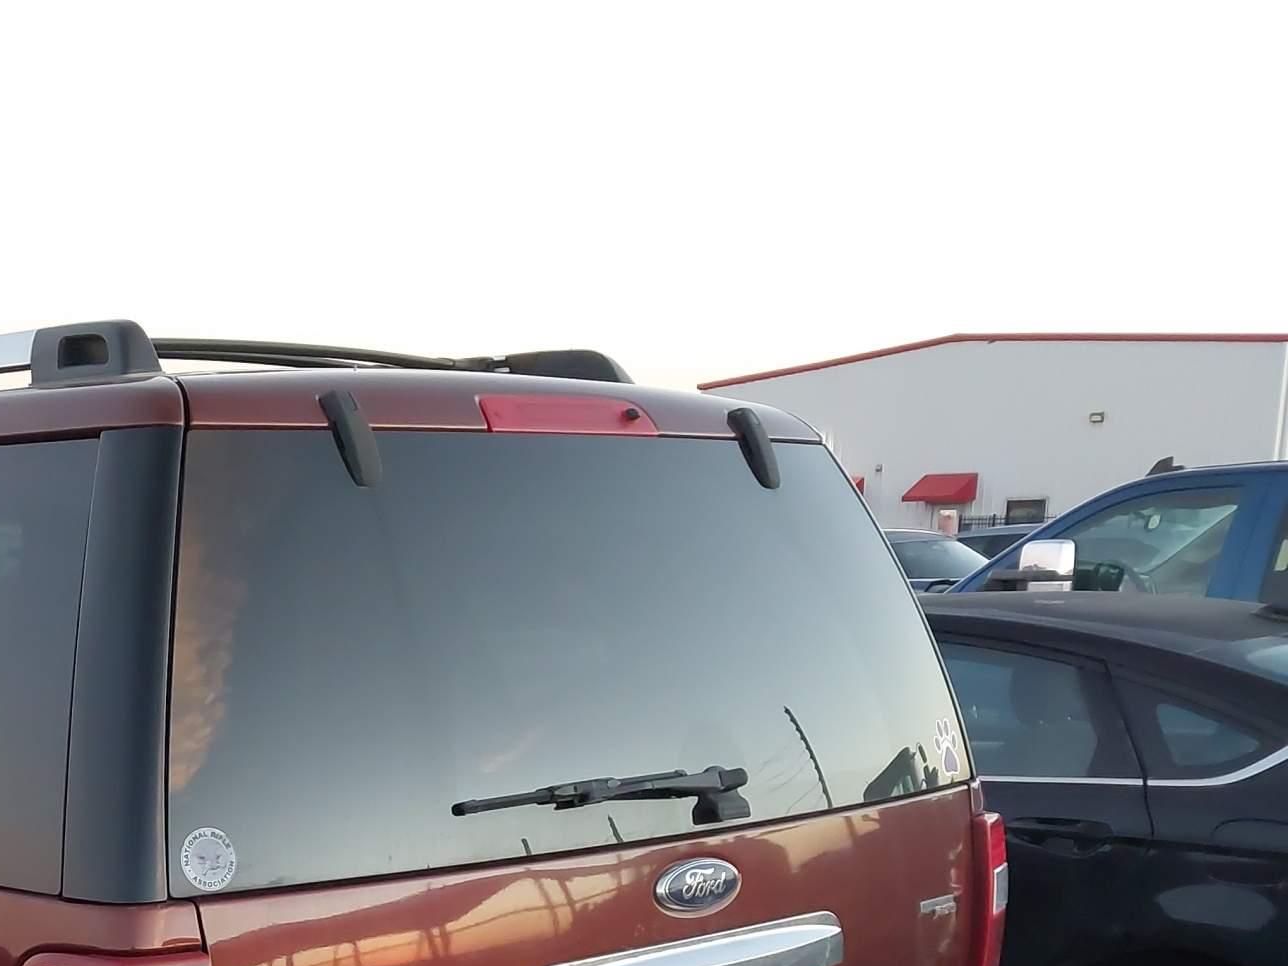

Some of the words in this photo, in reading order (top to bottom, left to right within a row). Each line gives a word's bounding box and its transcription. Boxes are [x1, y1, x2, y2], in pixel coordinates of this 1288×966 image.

[183, 832, 208, 867] NATIONAL
[210, 831, 231, 850] RIFLE
[192, 860, 234, 888] ASSOCIATION
[682, 867, 727, 900] Ford
